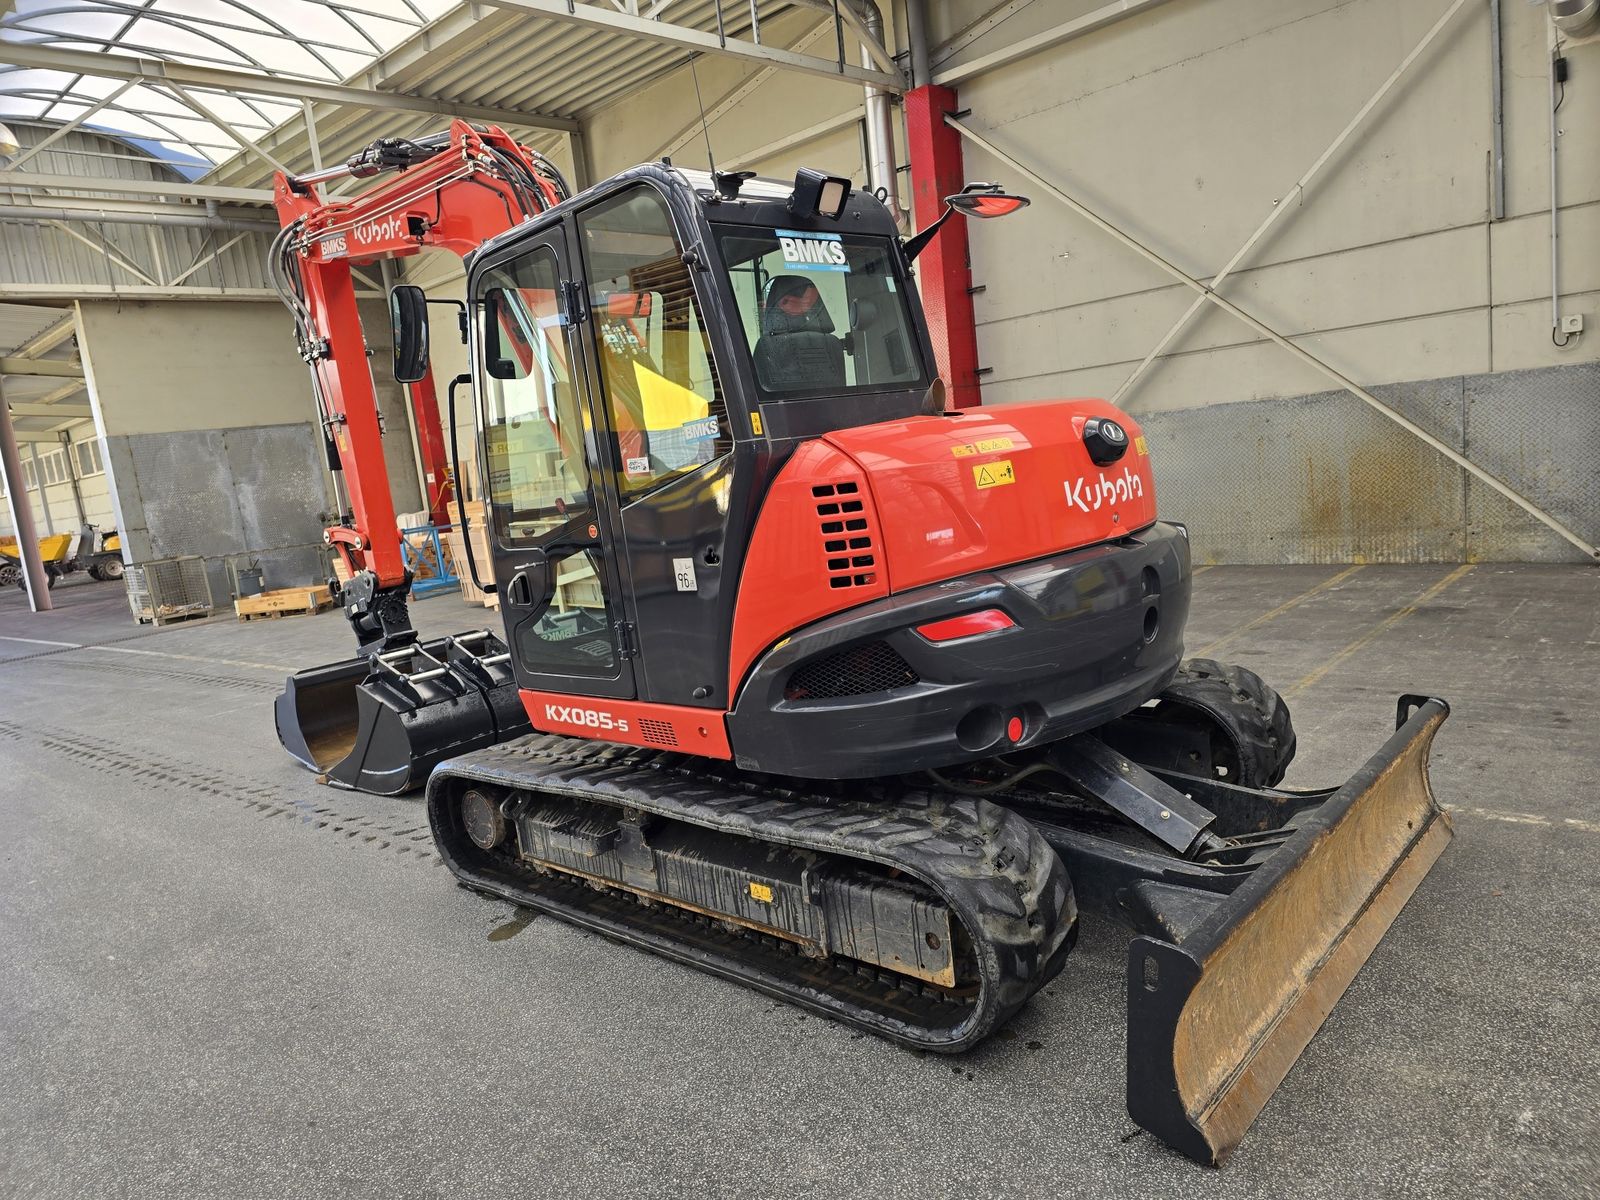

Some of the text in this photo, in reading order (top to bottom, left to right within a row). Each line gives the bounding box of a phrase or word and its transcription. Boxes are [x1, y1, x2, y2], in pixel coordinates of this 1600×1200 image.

[321, 237, 347, 255] BMKS
[779, 237, 846, 264] BMKS
[684, 420, 718, 440] BMKS
[1063, 467, 1143, 512] Kubota
[677, 572, 690, 589] 96
